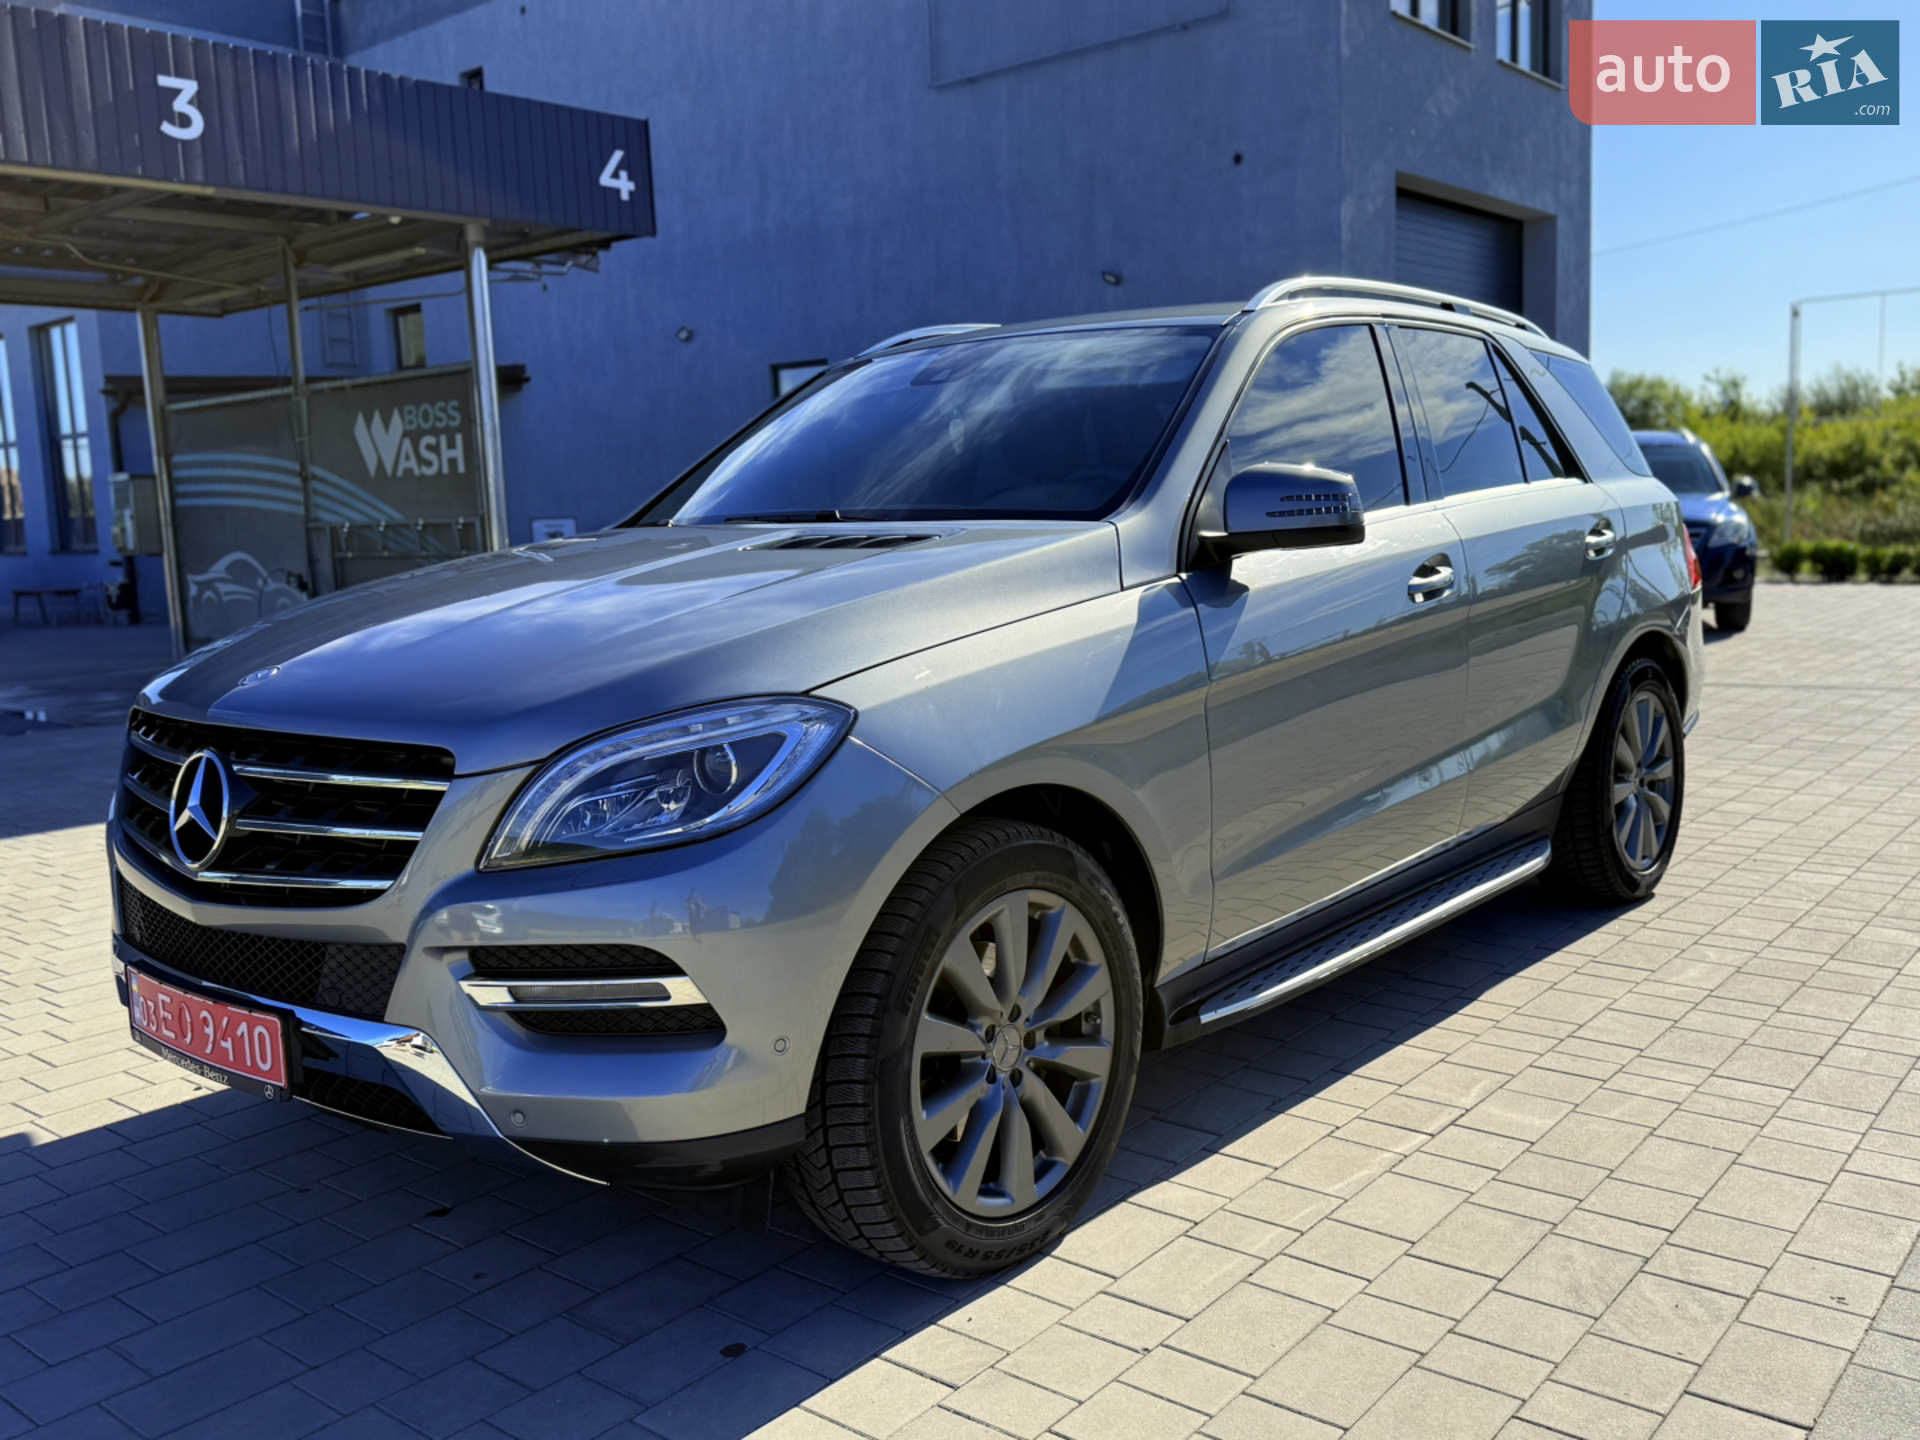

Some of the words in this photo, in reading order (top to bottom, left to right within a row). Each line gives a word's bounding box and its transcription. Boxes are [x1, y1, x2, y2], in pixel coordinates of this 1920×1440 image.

[156, 74, 205, 141] 3
[599, 149, 636, 201] 4
[403, 400, 462, 431] BOSS
[354, 407, 466, 479] WASH
[161, 1046, 229, 1085] Mercedes-Benz
